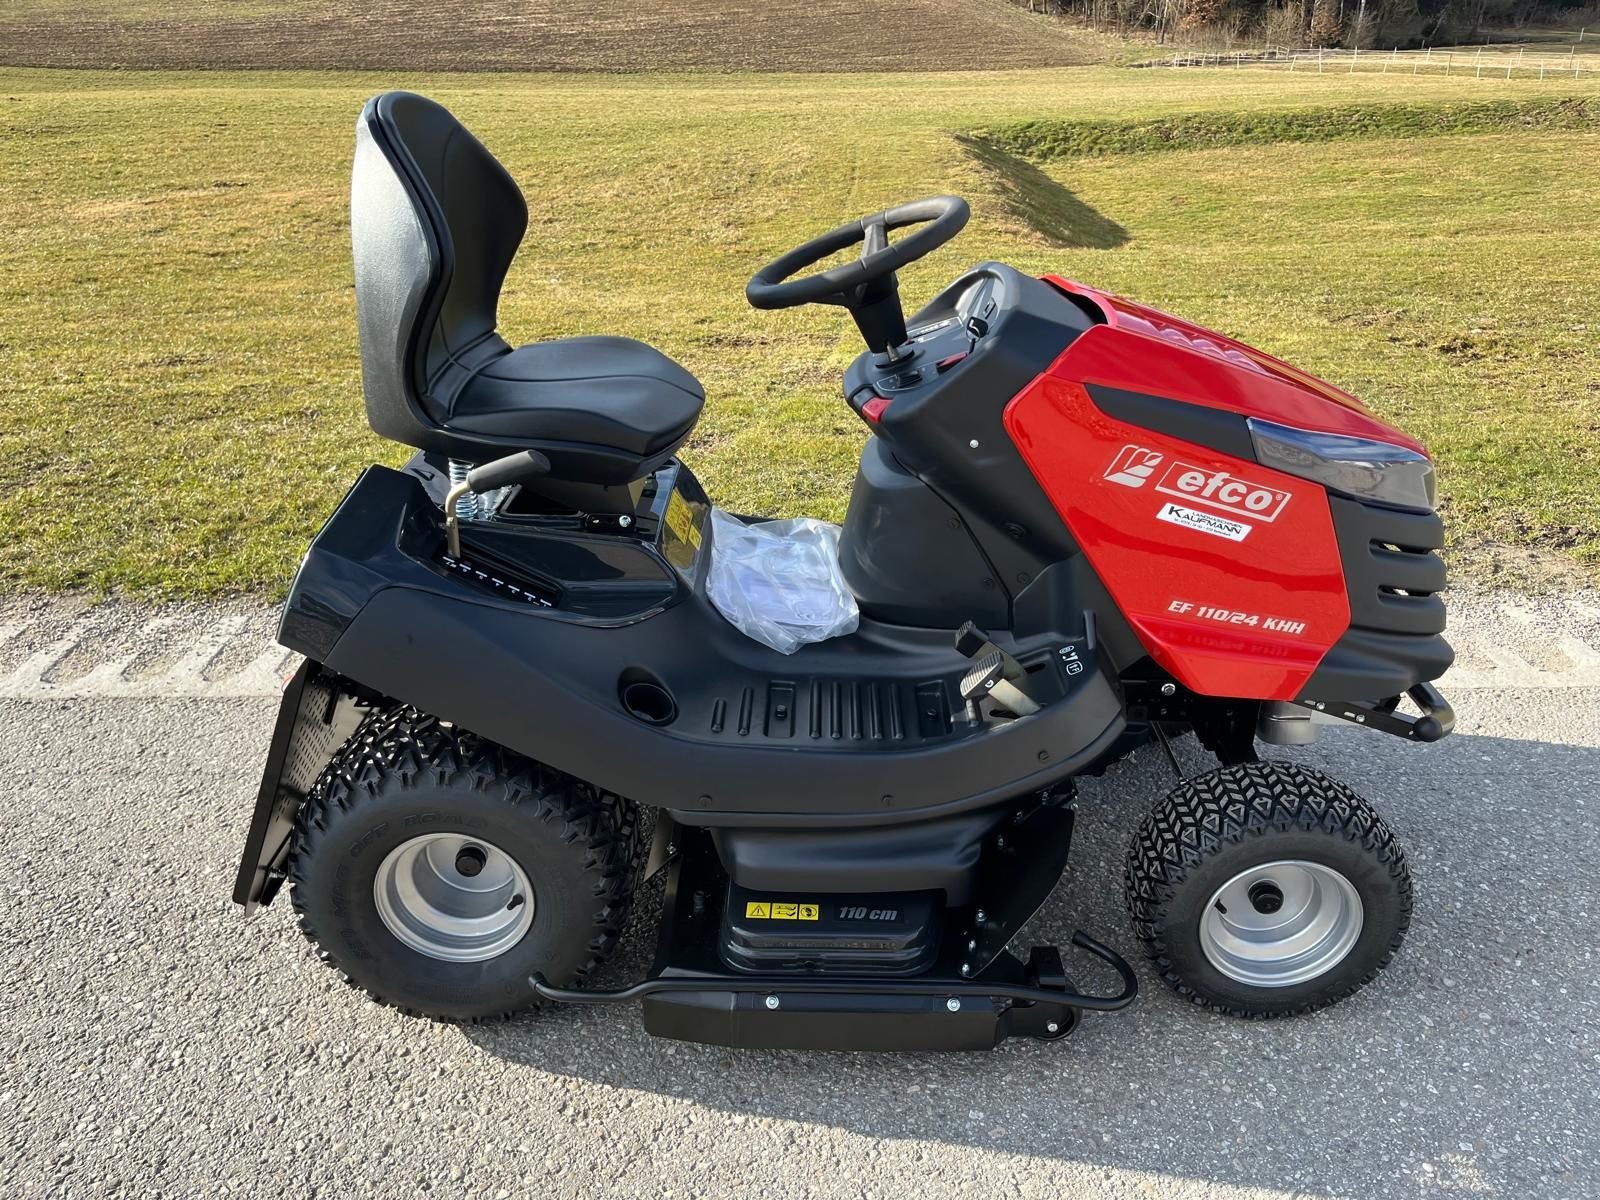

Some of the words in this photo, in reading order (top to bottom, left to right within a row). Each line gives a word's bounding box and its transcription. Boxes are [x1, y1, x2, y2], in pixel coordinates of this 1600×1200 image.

[1168, 505, 1242, 535] KAUFMANN
[1167, 600, 1195, 614] EF
[1197, 606, 1259, 627] 110/24
[1262, 617, 1305, 635] KHH
[839, 906, 867, 919] 110
[869, 910, 898, 921] cm
